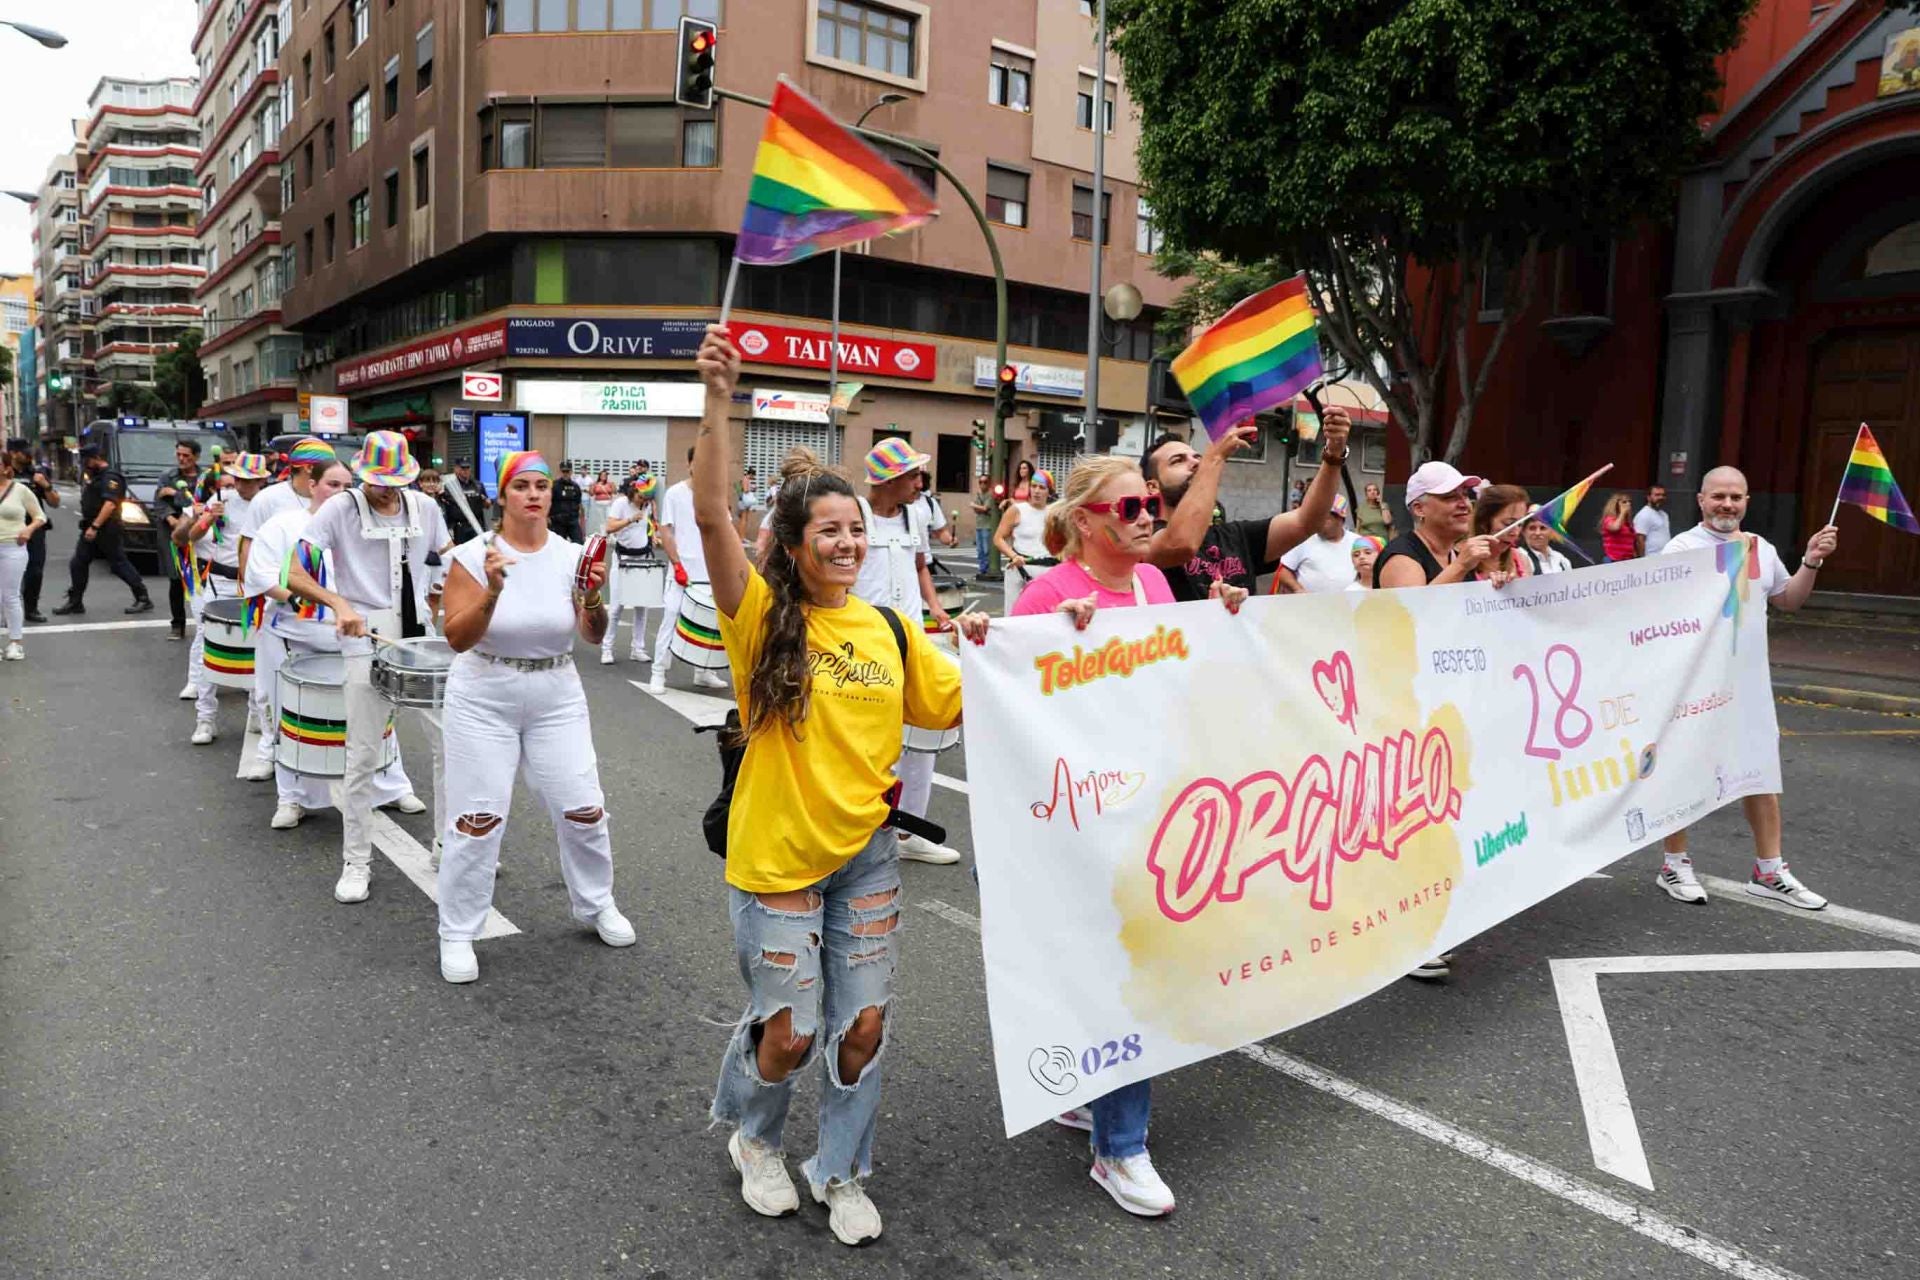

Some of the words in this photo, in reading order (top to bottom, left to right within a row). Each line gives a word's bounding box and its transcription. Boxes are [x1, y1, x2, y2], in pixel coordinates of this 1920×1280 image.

[785, 336, 881, 368] TAIWAN
[1483, 585, 1569, 613] Internacional
[1572, 583, 1593, 599] del
[1594, 573, 1642, 597] Orgullo
[1034, 624, 1190, 697] Tolerancia
[1432, 649, 1487, 674] RESPETO
[1512, 643, 1594, 761] 28
[1599, 693, 1640, 730] DE
[1031, 757, 1127, 832] Amor
[1474, 811, 1528, 867] Libertad
[1218, 949, 1294, 987] VEGA
[1310, 930, 1339, 954] DE
[1352, 909, 1389, 936] SAN
[1399, 877, 1454, 915] MATEO
[1081, 1033, 1142, 1075] 028
